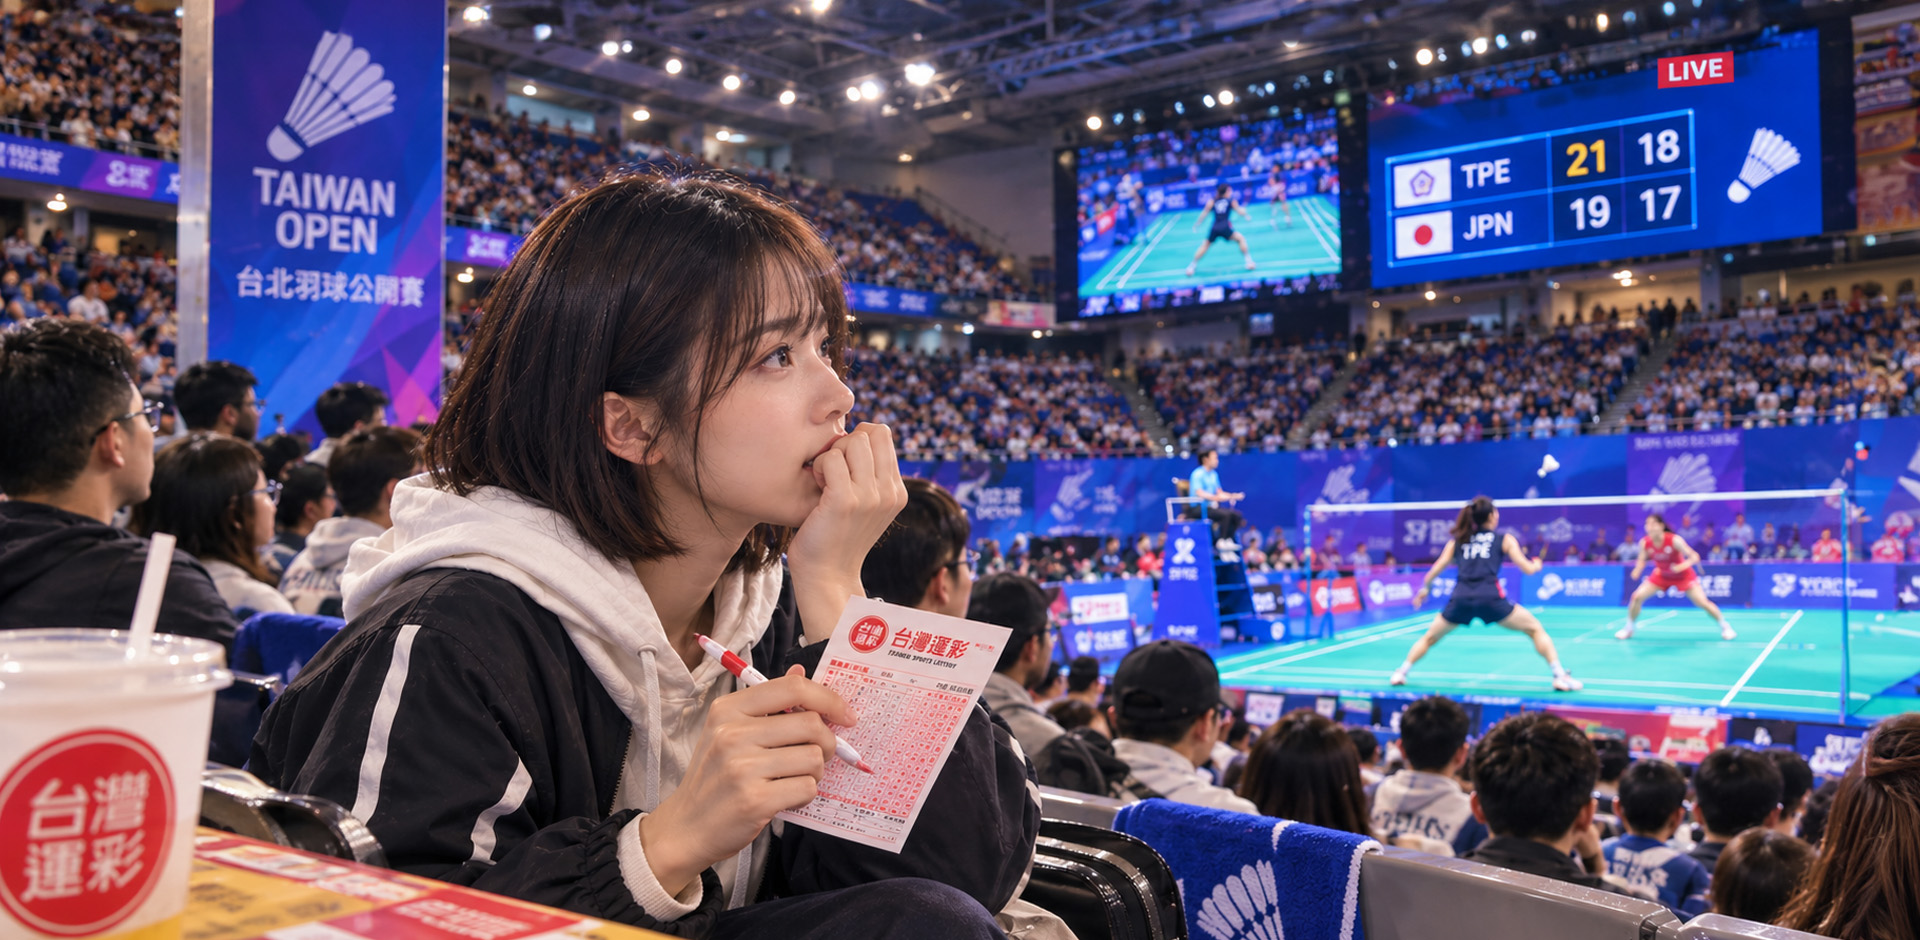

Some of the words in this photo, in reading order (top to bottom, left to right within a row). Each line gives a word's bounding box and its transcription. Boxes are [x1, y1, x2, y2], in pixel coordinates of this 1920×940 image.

[1668, 57, 1724, 82] LIVE
[1460, 158, 1511, 189] TPE
[1566, 139, 1606, 177] 21
[1637, 129, 1681, 166] 18
[252, 166, 396, 218] TAIWAN
[1463, 211, 1513, 241] JPN
[1569, 194, 1611, 231] 19
[1639, 185, 1682, 222] 17
[275, 210, 378, 255] OPEN
[236, 264, 425, 308] 台北羽球公開賽
[1461, 542, 1492, 560] TPE
[27, 769, 150, 840] 台灣
[20, 829, 145, 902] 運彩
